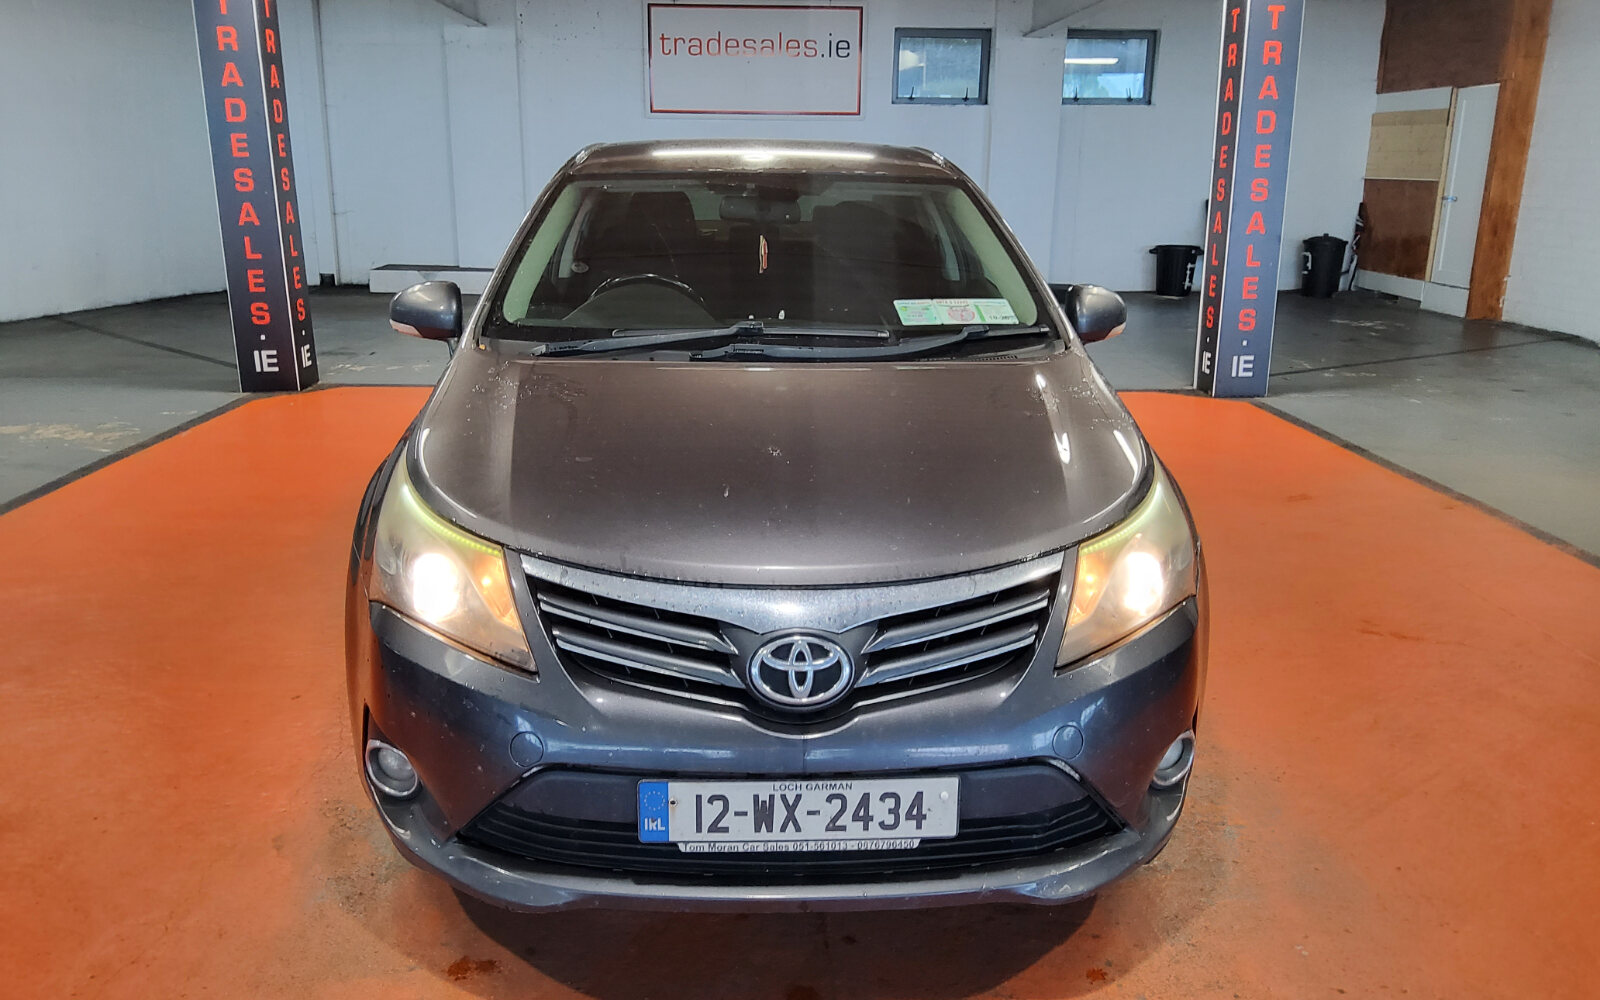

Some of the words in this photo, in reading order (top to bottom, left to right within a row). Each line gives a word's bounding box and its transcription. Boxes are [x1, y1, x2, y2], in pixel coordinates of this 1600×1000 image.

[659, 31, 851, 59] tradesales.ie
[772, 783, 802, 791] LOCH
[805, 782, 853, 791] GARMAN
[695, 791, 927, 834] 12-WX-2434
[644, 817, 666, 831] IRL
[684, 842, 705, 852] Tom
[708, 842, 739, 852] Moran
[742, 842, 760, 852] Car
[763, 841, 789, 852] Sales
